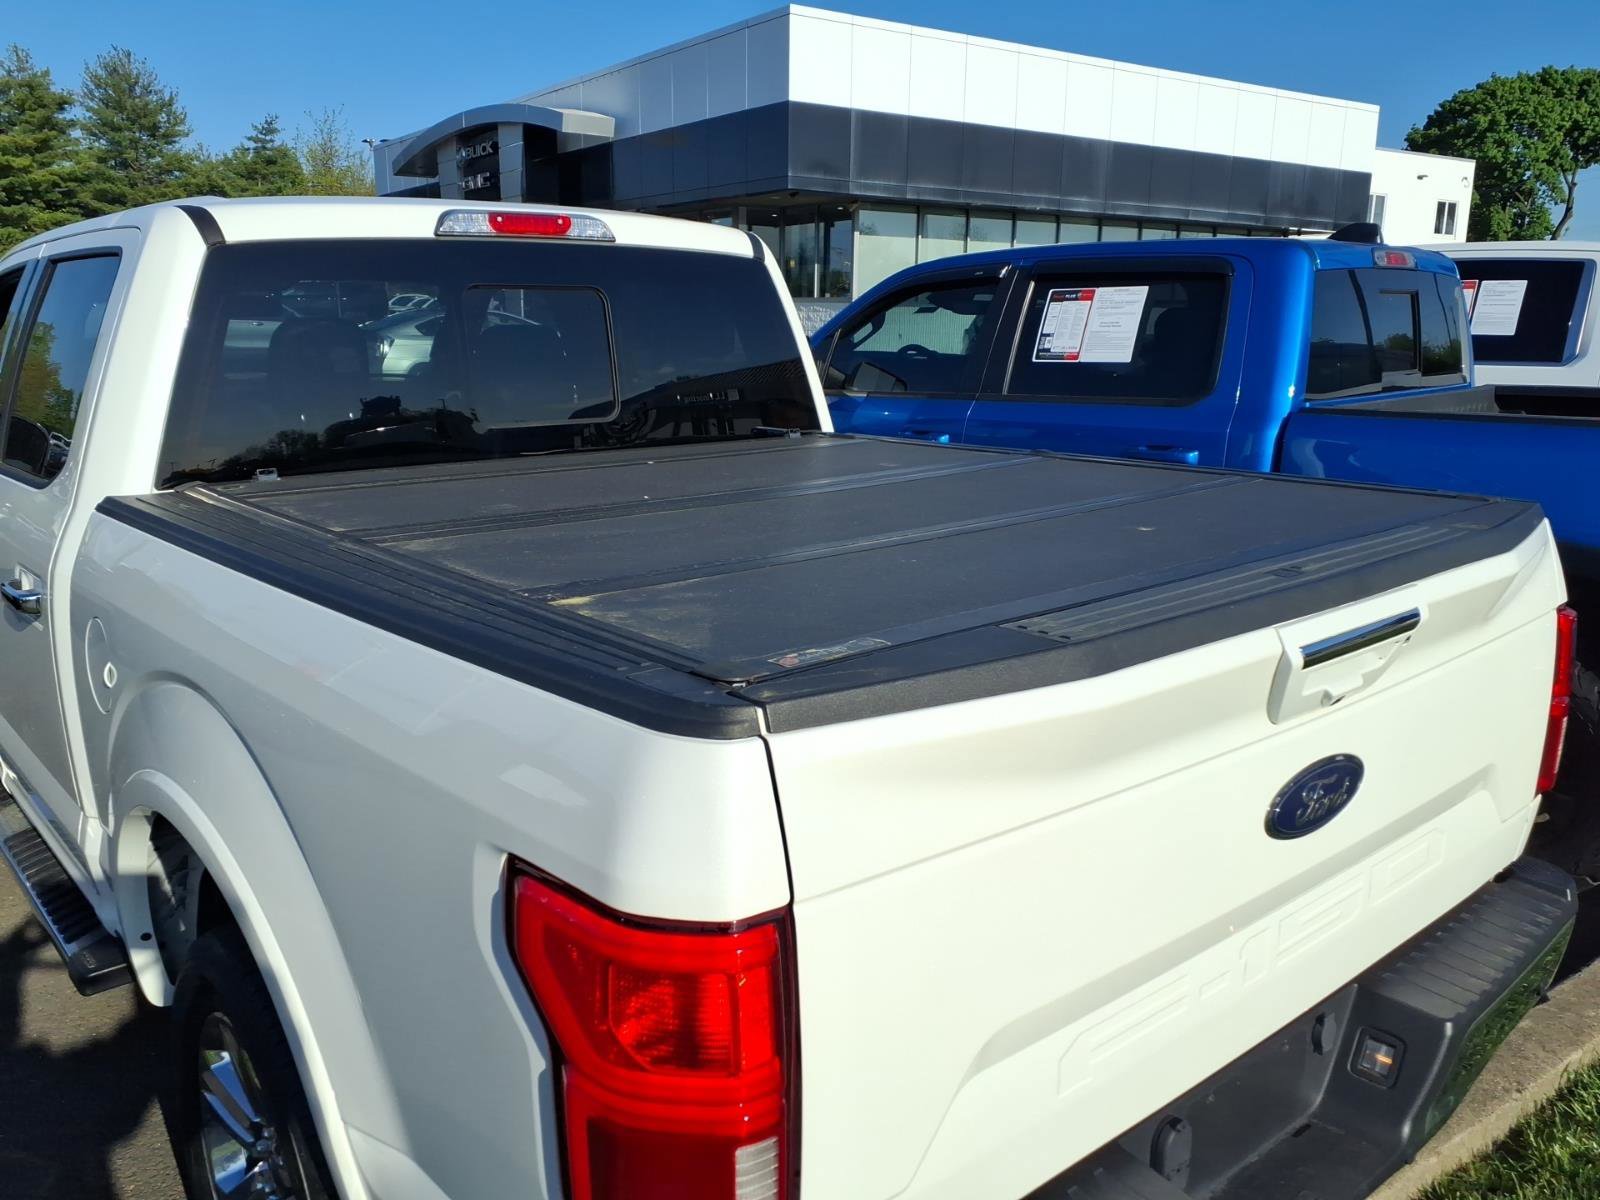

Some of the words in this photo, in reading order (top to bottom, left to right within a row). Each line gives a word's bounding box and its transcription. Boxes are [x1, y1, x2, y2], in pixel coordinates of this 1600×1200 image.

[466, 140, 493, 159] BUICK
[462, 171, 490, 191] GMC
[1295, 773, 1350, 827] Ford
[1057, 828, 1446, 1099] F-150
